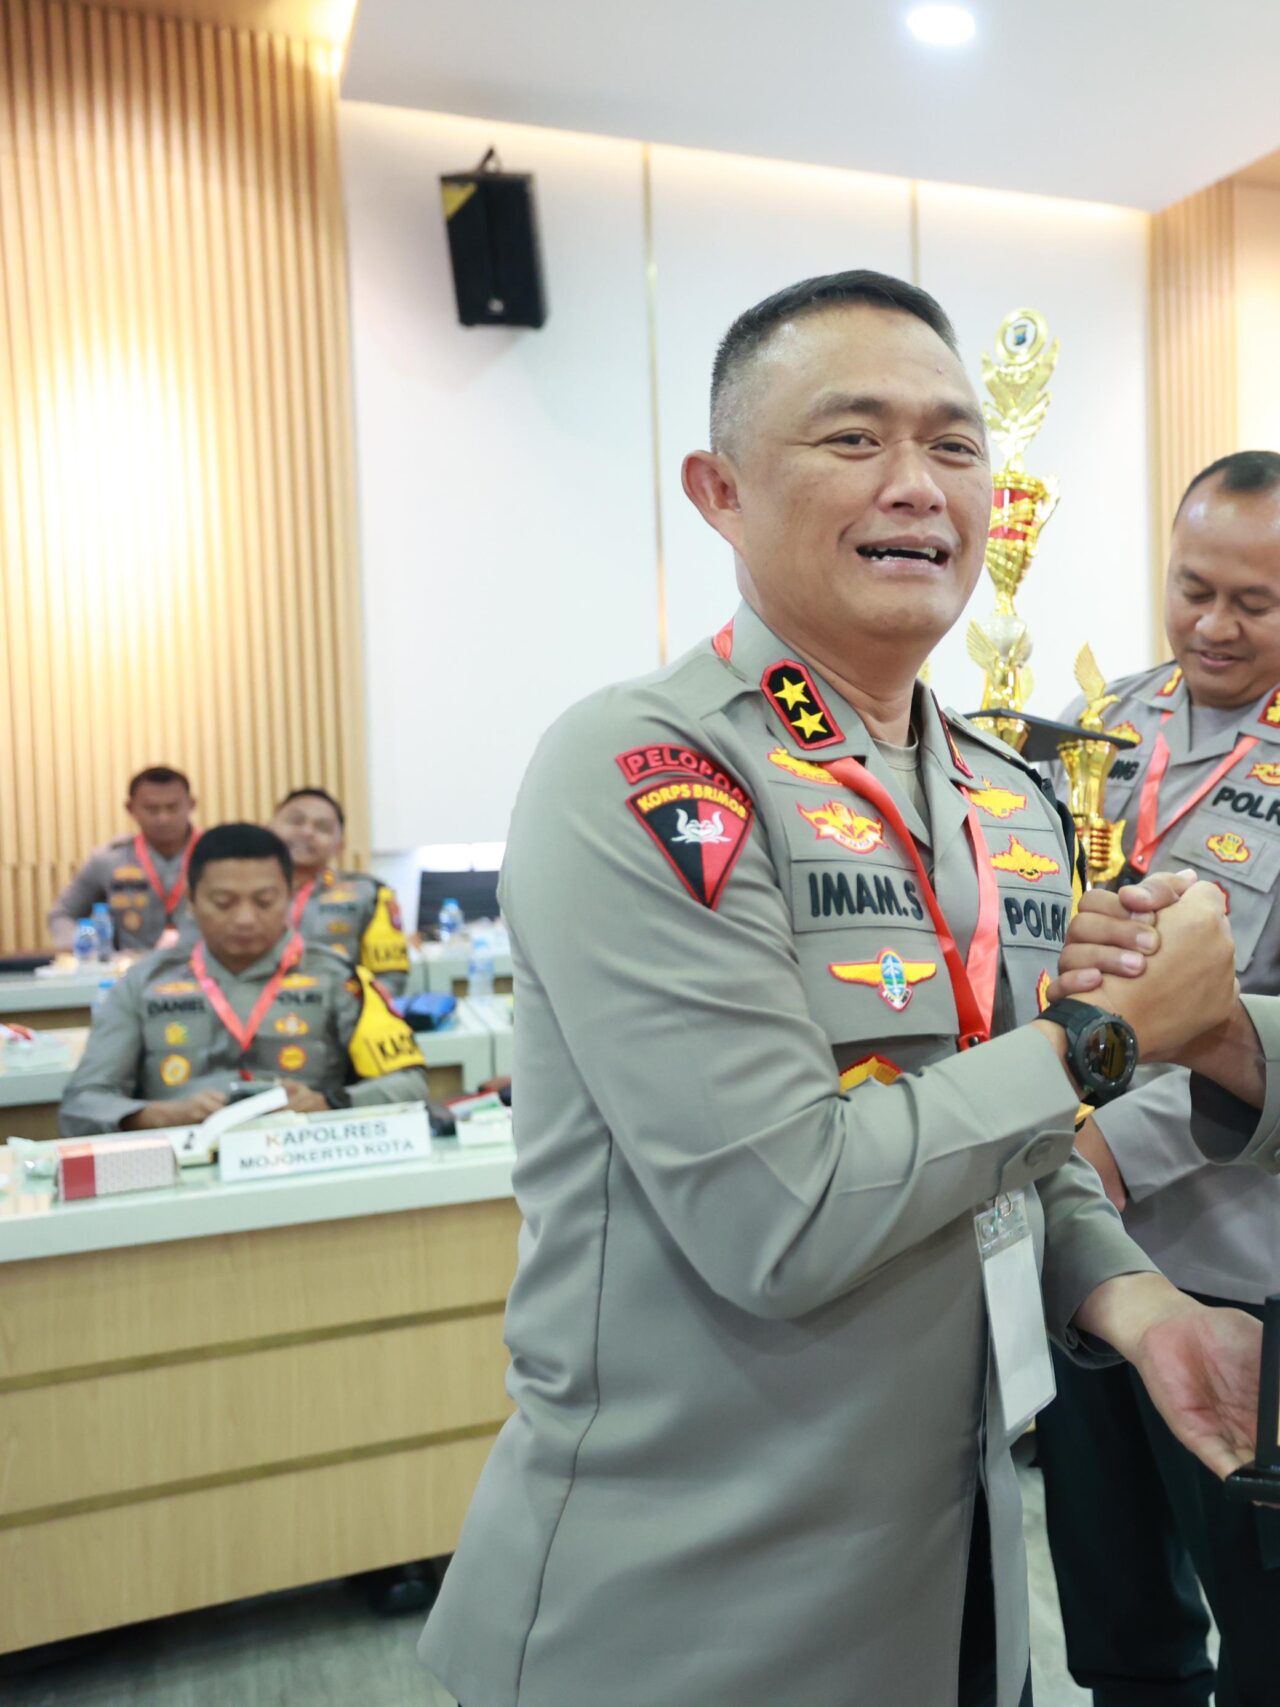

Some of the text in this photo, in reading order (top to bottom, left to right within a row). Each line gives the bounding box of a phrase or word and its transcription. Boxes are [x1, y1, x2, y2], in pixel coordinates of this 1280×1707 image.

[637, 784, 746, 818] KORPS BRIMOB
[809, 871, 924, 921] IMAM.S
[1004, 897, 1067, 943] POLRI
[265, 1120, 388, 1147] KAPOLRES
[239, 1140, 414, 1169] MOJOKERTO KOTA
